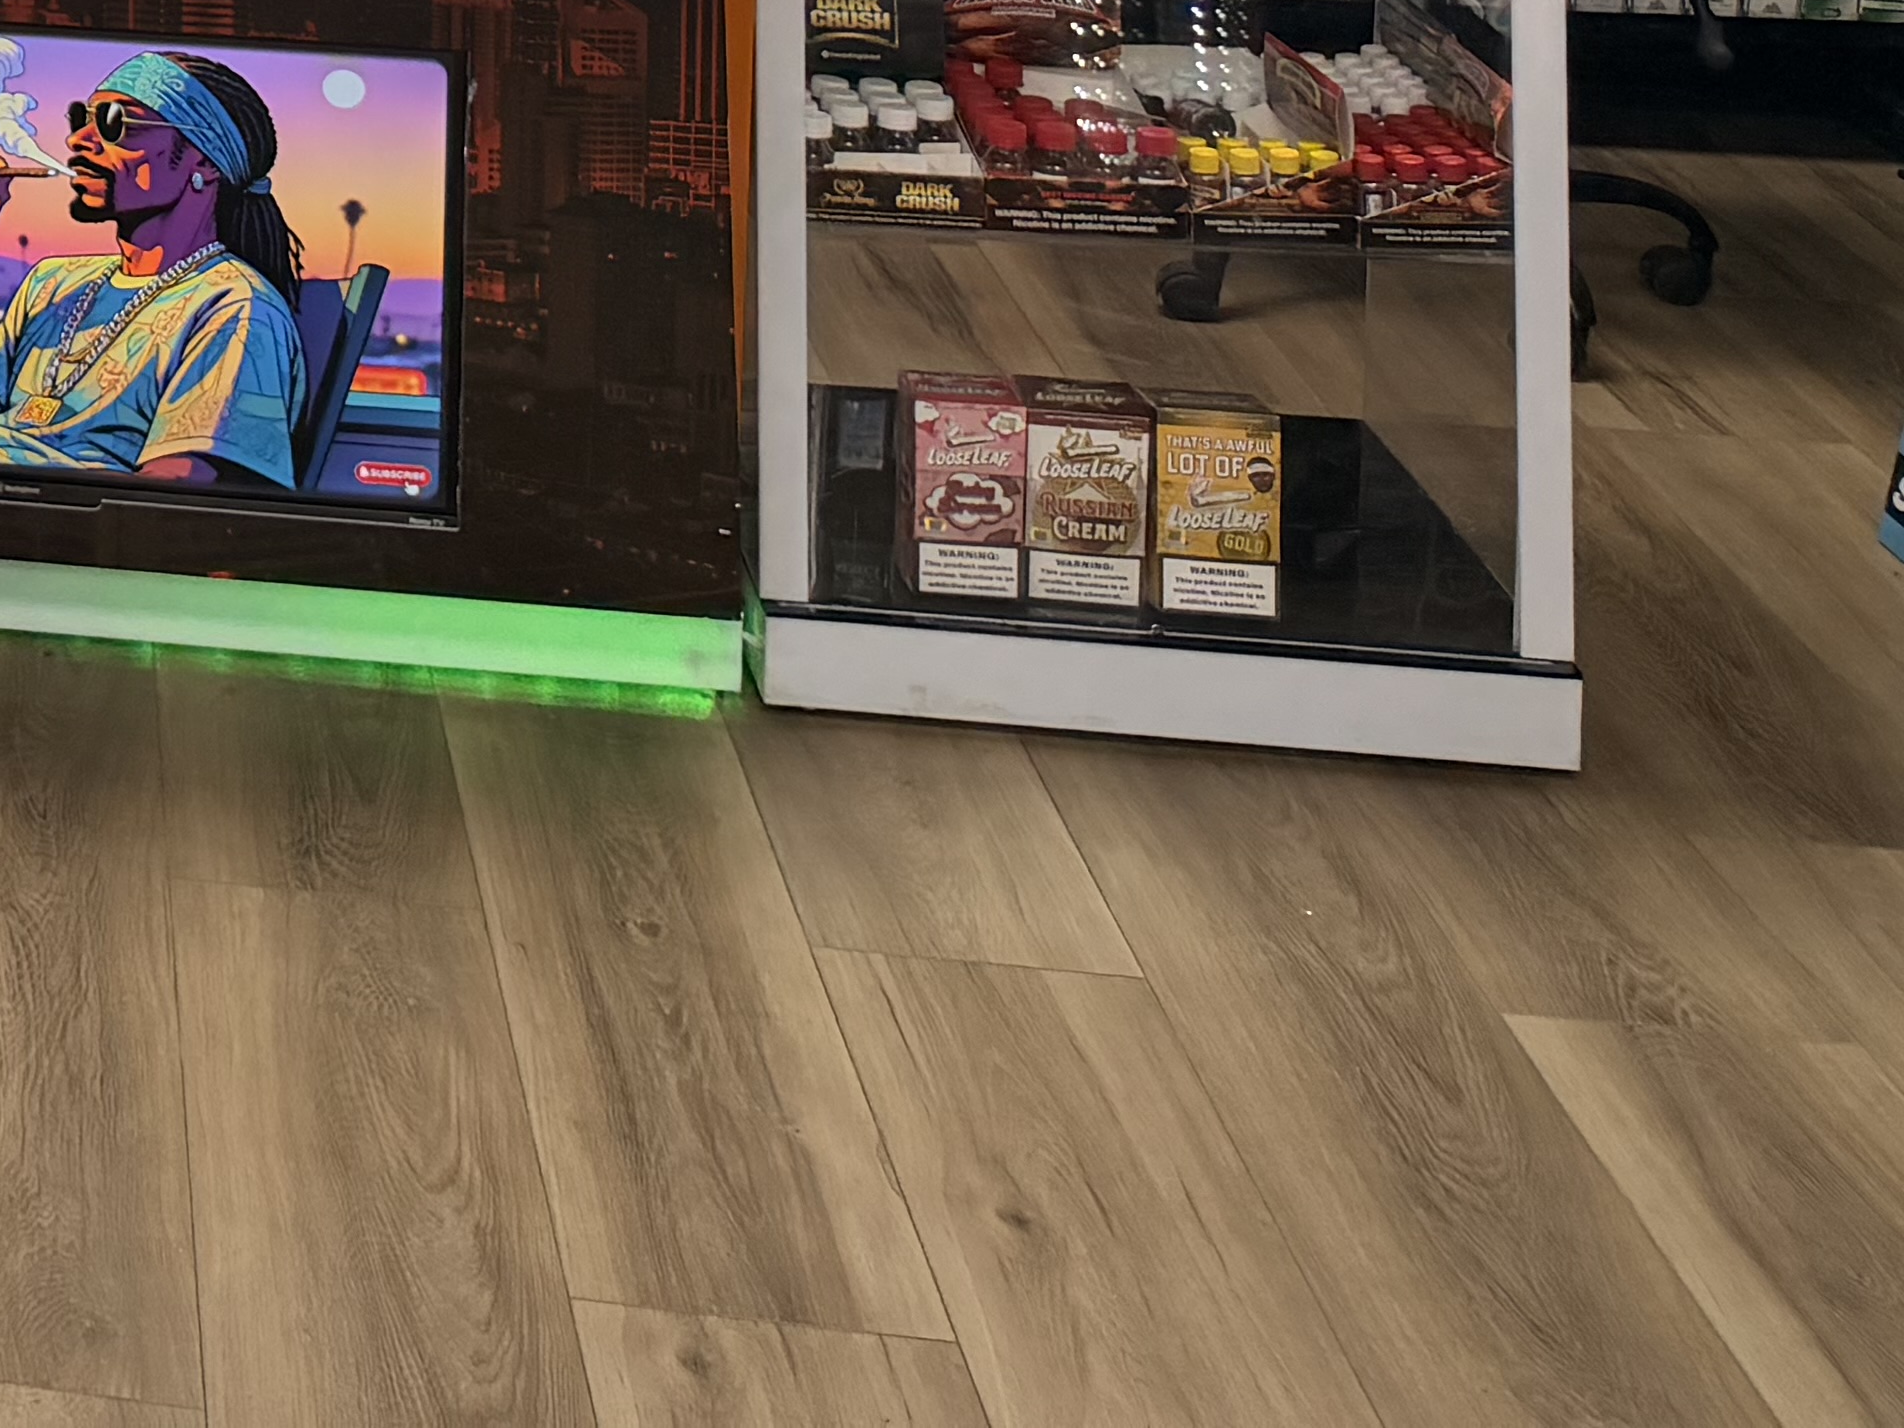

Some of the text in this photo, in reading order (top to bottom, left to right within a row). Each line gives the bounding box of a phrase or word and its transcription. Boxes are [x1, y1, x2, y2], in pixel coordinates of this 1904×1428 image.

[810, 10, 891, 30] CRUSH
[901, 181, 951, 197] DARK
[895, 195, 960, 213] CRUSH
[1166, 435, 1211, 453] THAT'S
[1226, 438, 1274, 455] AWFUL
[370, 468, 426, 483] SUBSCRIBE
[1166, 455, 1244, 478] LOT OF
[1041, 496, 1136, 519] RUSSIAN
[1053, 518, 1126, 542] CREAM
[1223, 533, 1266, 553] GOLD
